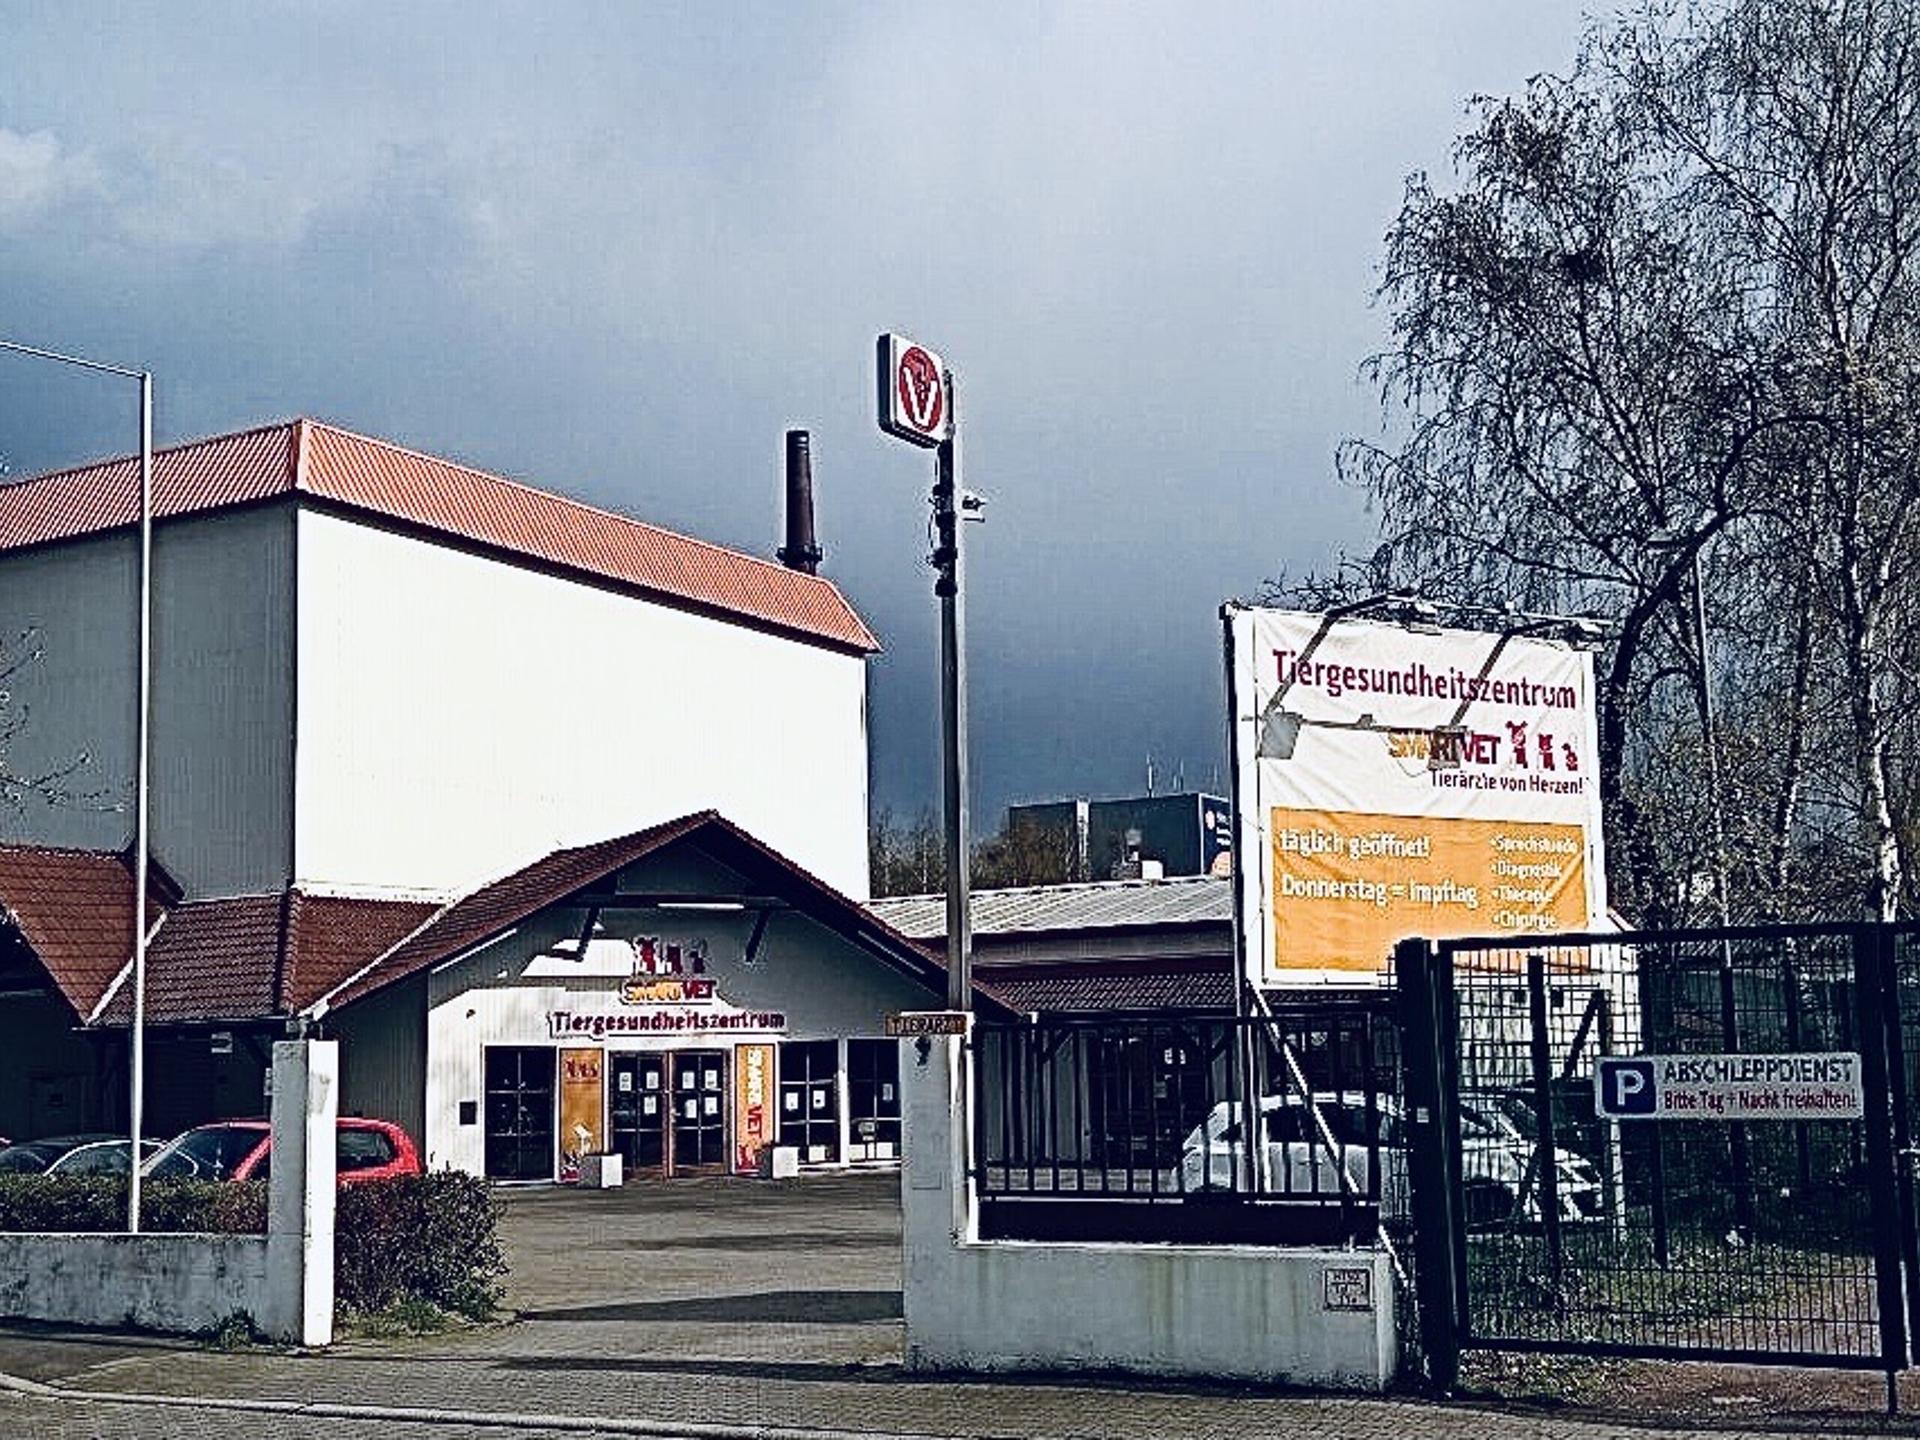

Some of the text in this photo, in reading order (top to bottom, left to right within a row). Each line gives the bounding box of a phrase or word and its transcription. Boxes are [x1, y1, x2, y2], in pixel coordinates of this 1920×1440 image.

[1272, 648, 1577, 709] Tiergesundheitszentrum
[1430, 769, 1583, 794] Tierärzte von Herzen!
[1280, 828, 1430, 859] täglich geöffnet!
[1281, 874, 1479, 909] Donnerstag = Impftag
[553, 1010, 786, 1035] Tiergesundheitszentrum
[1615, 1057, 1853, 1106] P ABSCHLEPPDIENST
[1664, 1088, 1857, 1114] Bitte Tag + Nacht freihalten!
